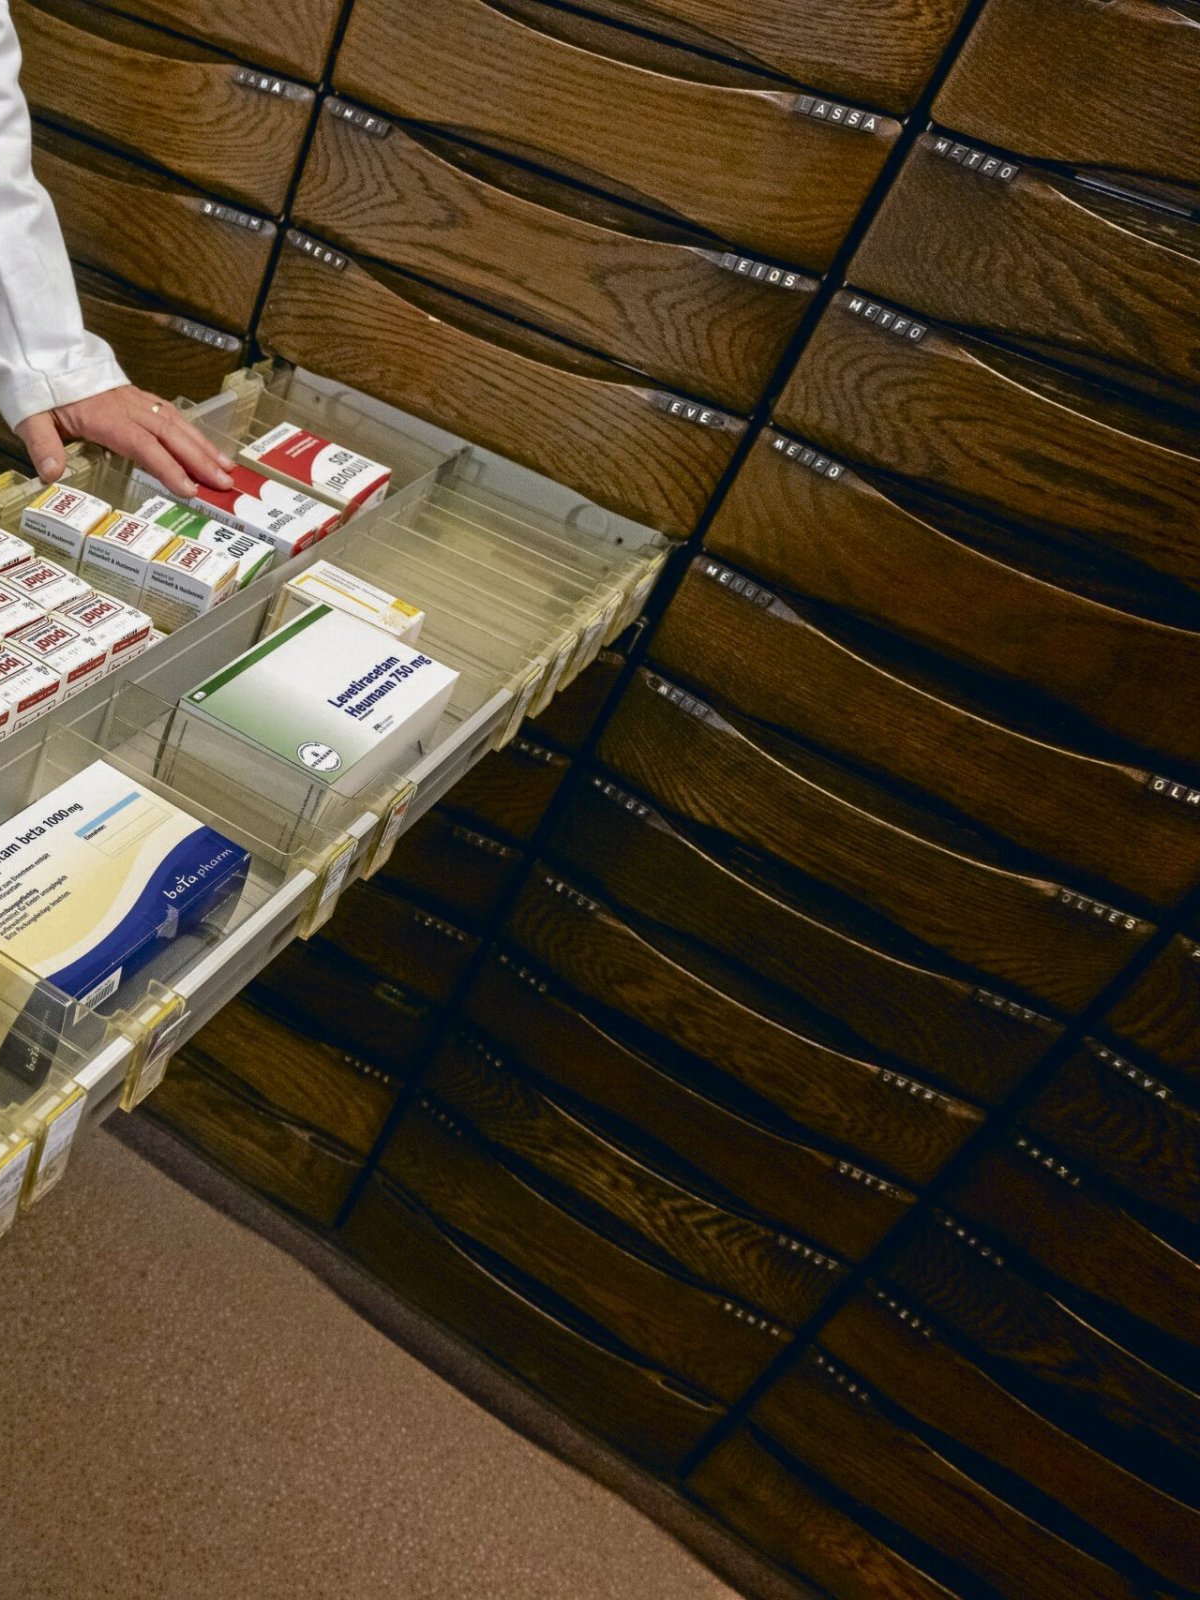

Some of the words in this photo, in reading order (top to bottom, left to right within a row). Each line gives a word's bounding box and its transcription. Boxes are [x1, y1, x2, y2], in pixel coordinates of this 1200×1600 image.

[934, 140, 1012, 179] METFO
[849, 299, 922, 339] METFO
[772, 438, 840, 478] METFO
[52, 493, 81, 515] ipalat
[115, 520, 144, 543] ipalat
[178, 546, 207, 569] ipalat
[79, 602, 118, 624] ipalat
[33, 628, 73, 652] ipalat
[327, 655, 401, 709] Levetiracetam
[343, 679, 397, 718] Heumann
[388, 664, 415, 683] 750
[409, 654, 433, 669] mg
[15, 825, 47, 845] beta
[196, 848, 234, 878] pharm
[1061, 894, 1136, 929] OLMES
